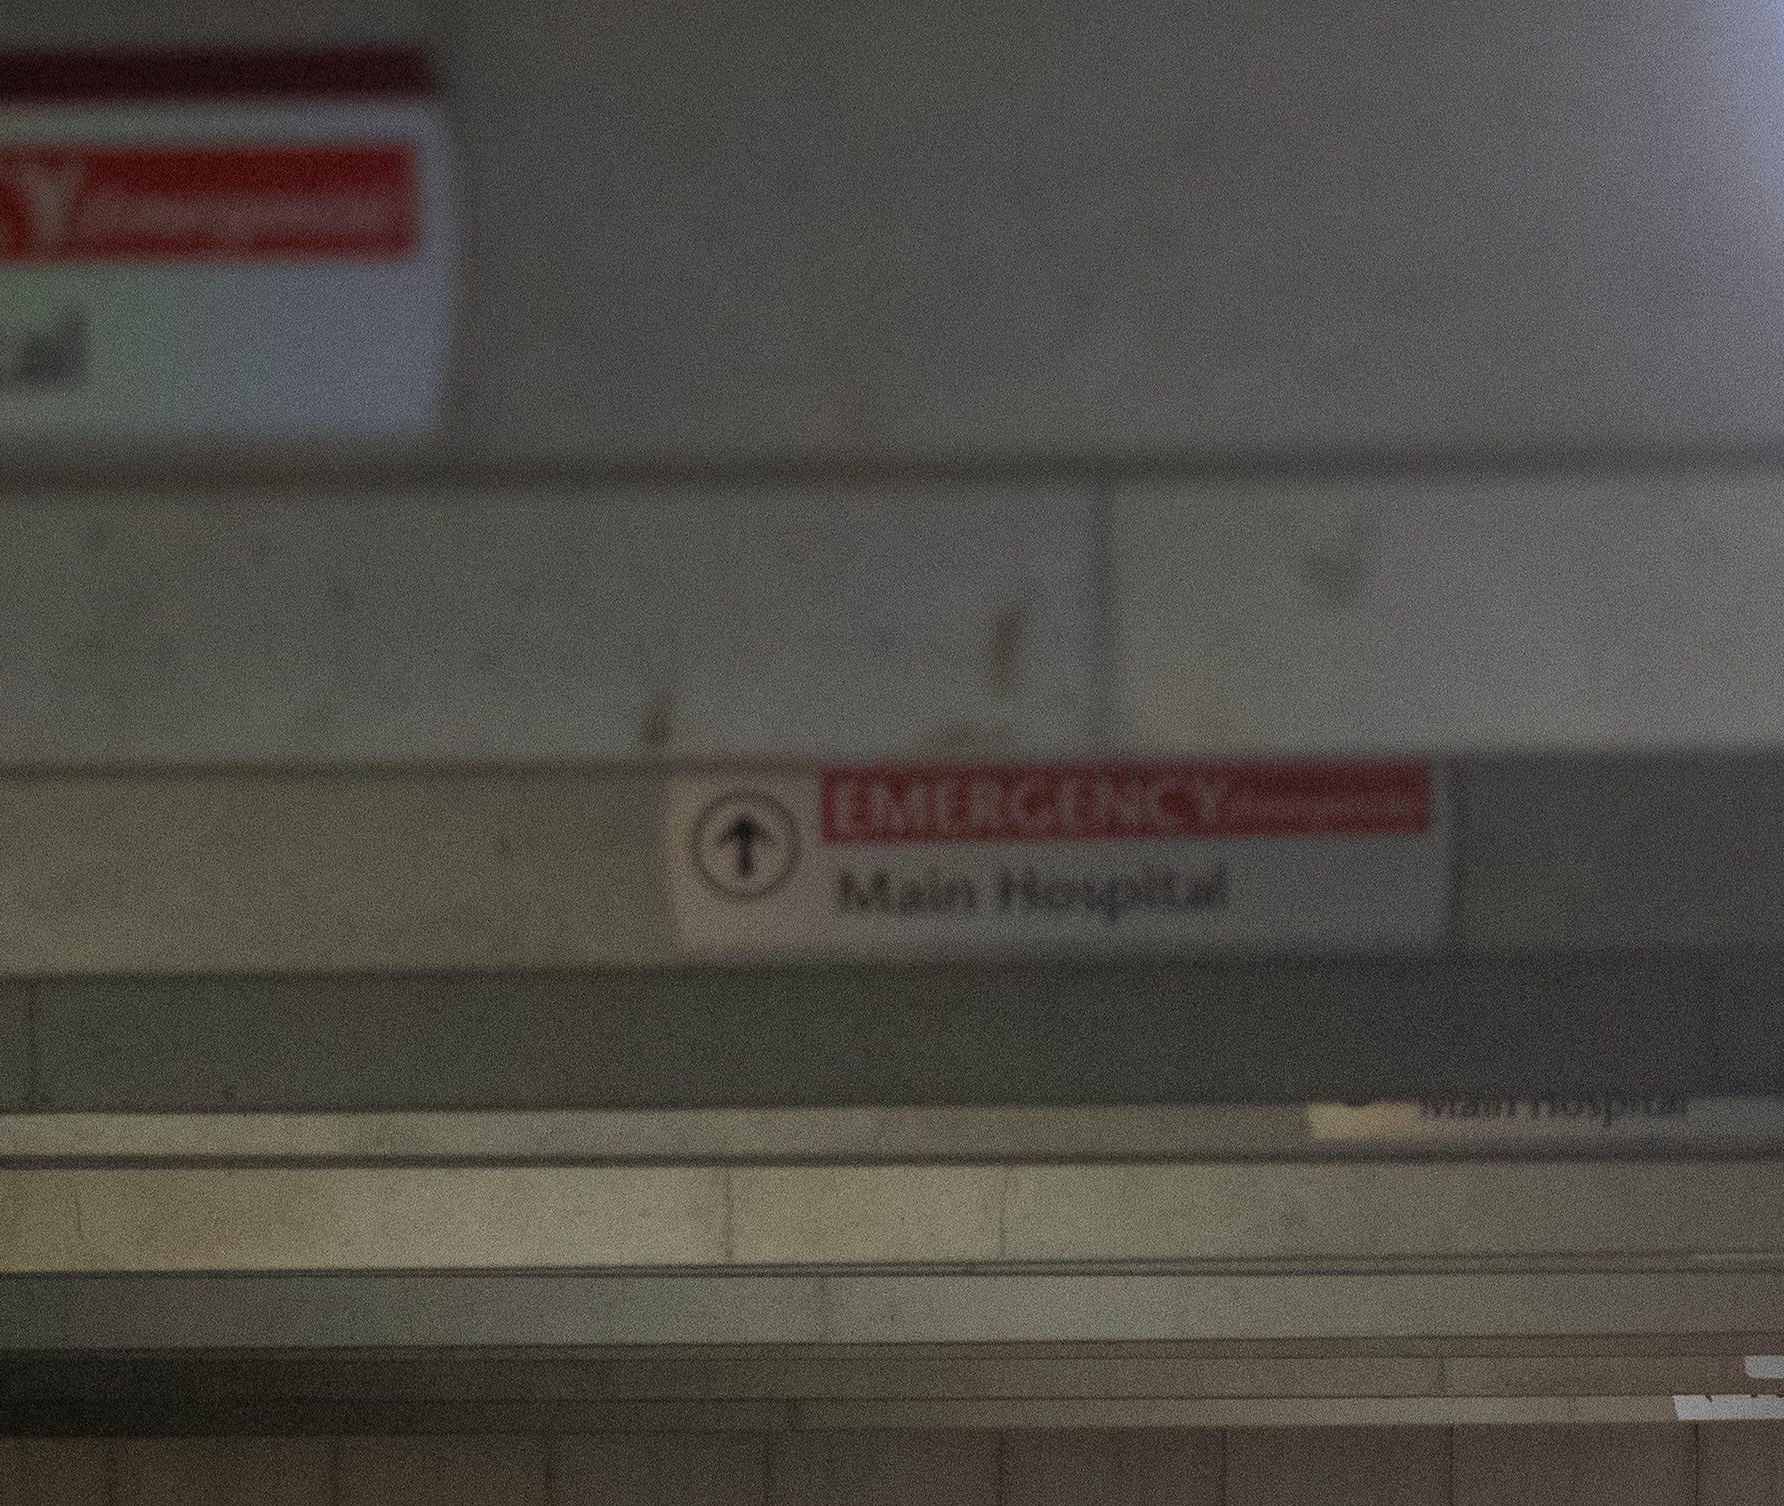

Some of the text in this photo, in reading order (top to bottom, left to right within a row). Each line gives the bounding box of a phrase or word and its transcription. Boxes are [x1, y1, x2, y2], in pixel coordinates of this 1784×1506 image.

[834, 778, 1229, 832] EMERGENCY
[837, 861, 1229, 922] Main Hospital
